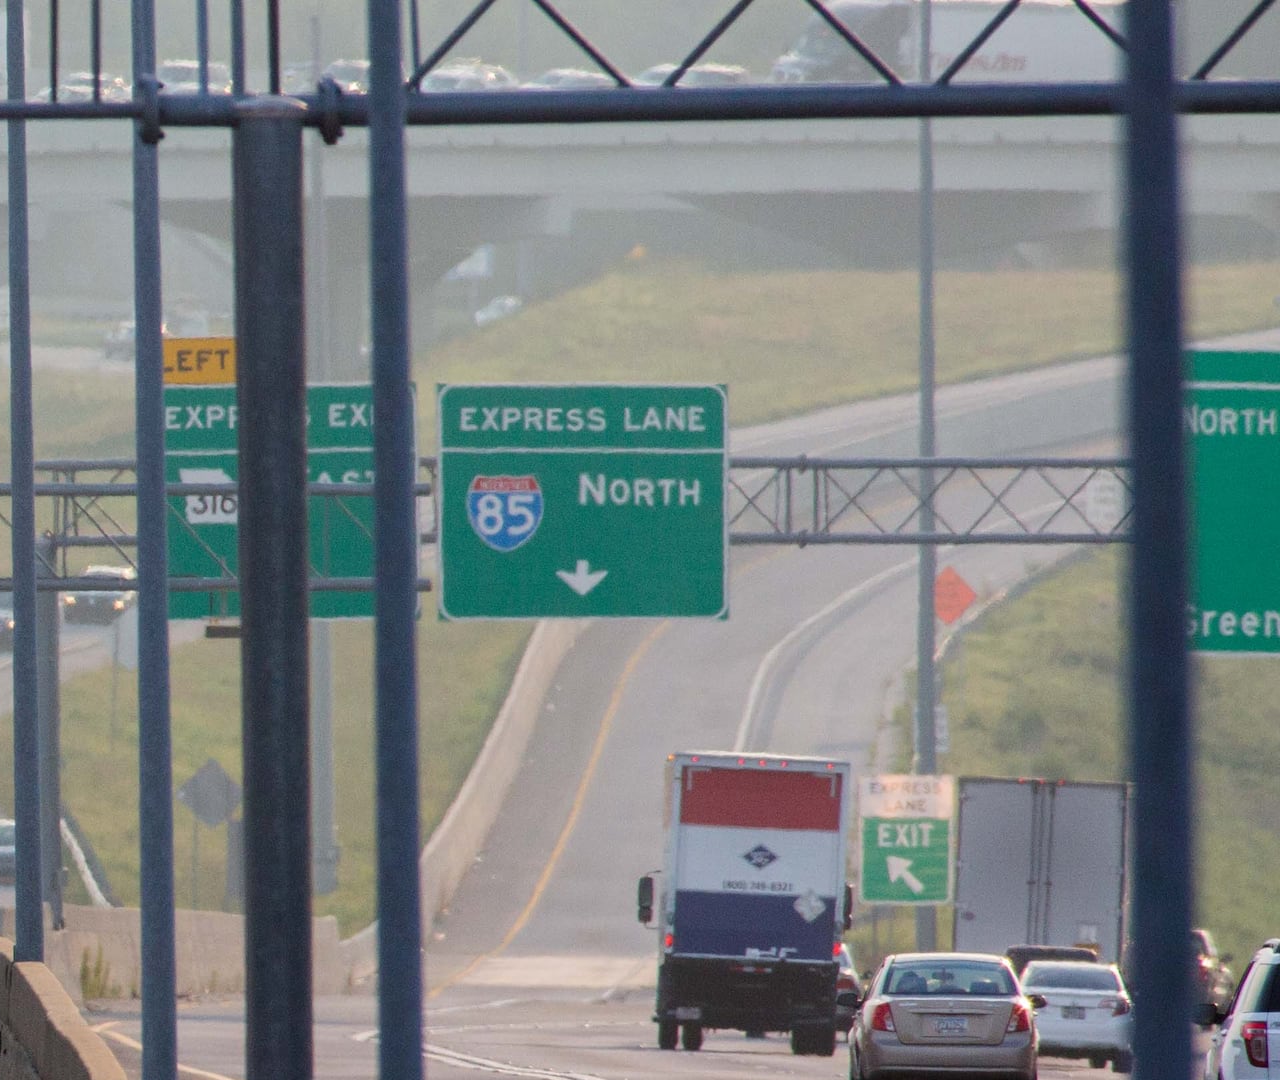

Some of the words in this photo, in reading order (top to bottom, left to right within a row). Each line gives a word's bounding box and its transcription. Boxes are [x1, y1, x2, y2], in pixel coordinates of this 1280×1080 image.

[460, 407, 606, 432] EXPRESS
[623, 407, 706, 432] LANE
[578, 473, 701, 506] NORTH
[477, 494, 535, 535] 85
[870, 782, 943, 794] EXPRESS
[884, 799, 927, 813] LANE
[878, 823, 934, 848] EXIT
